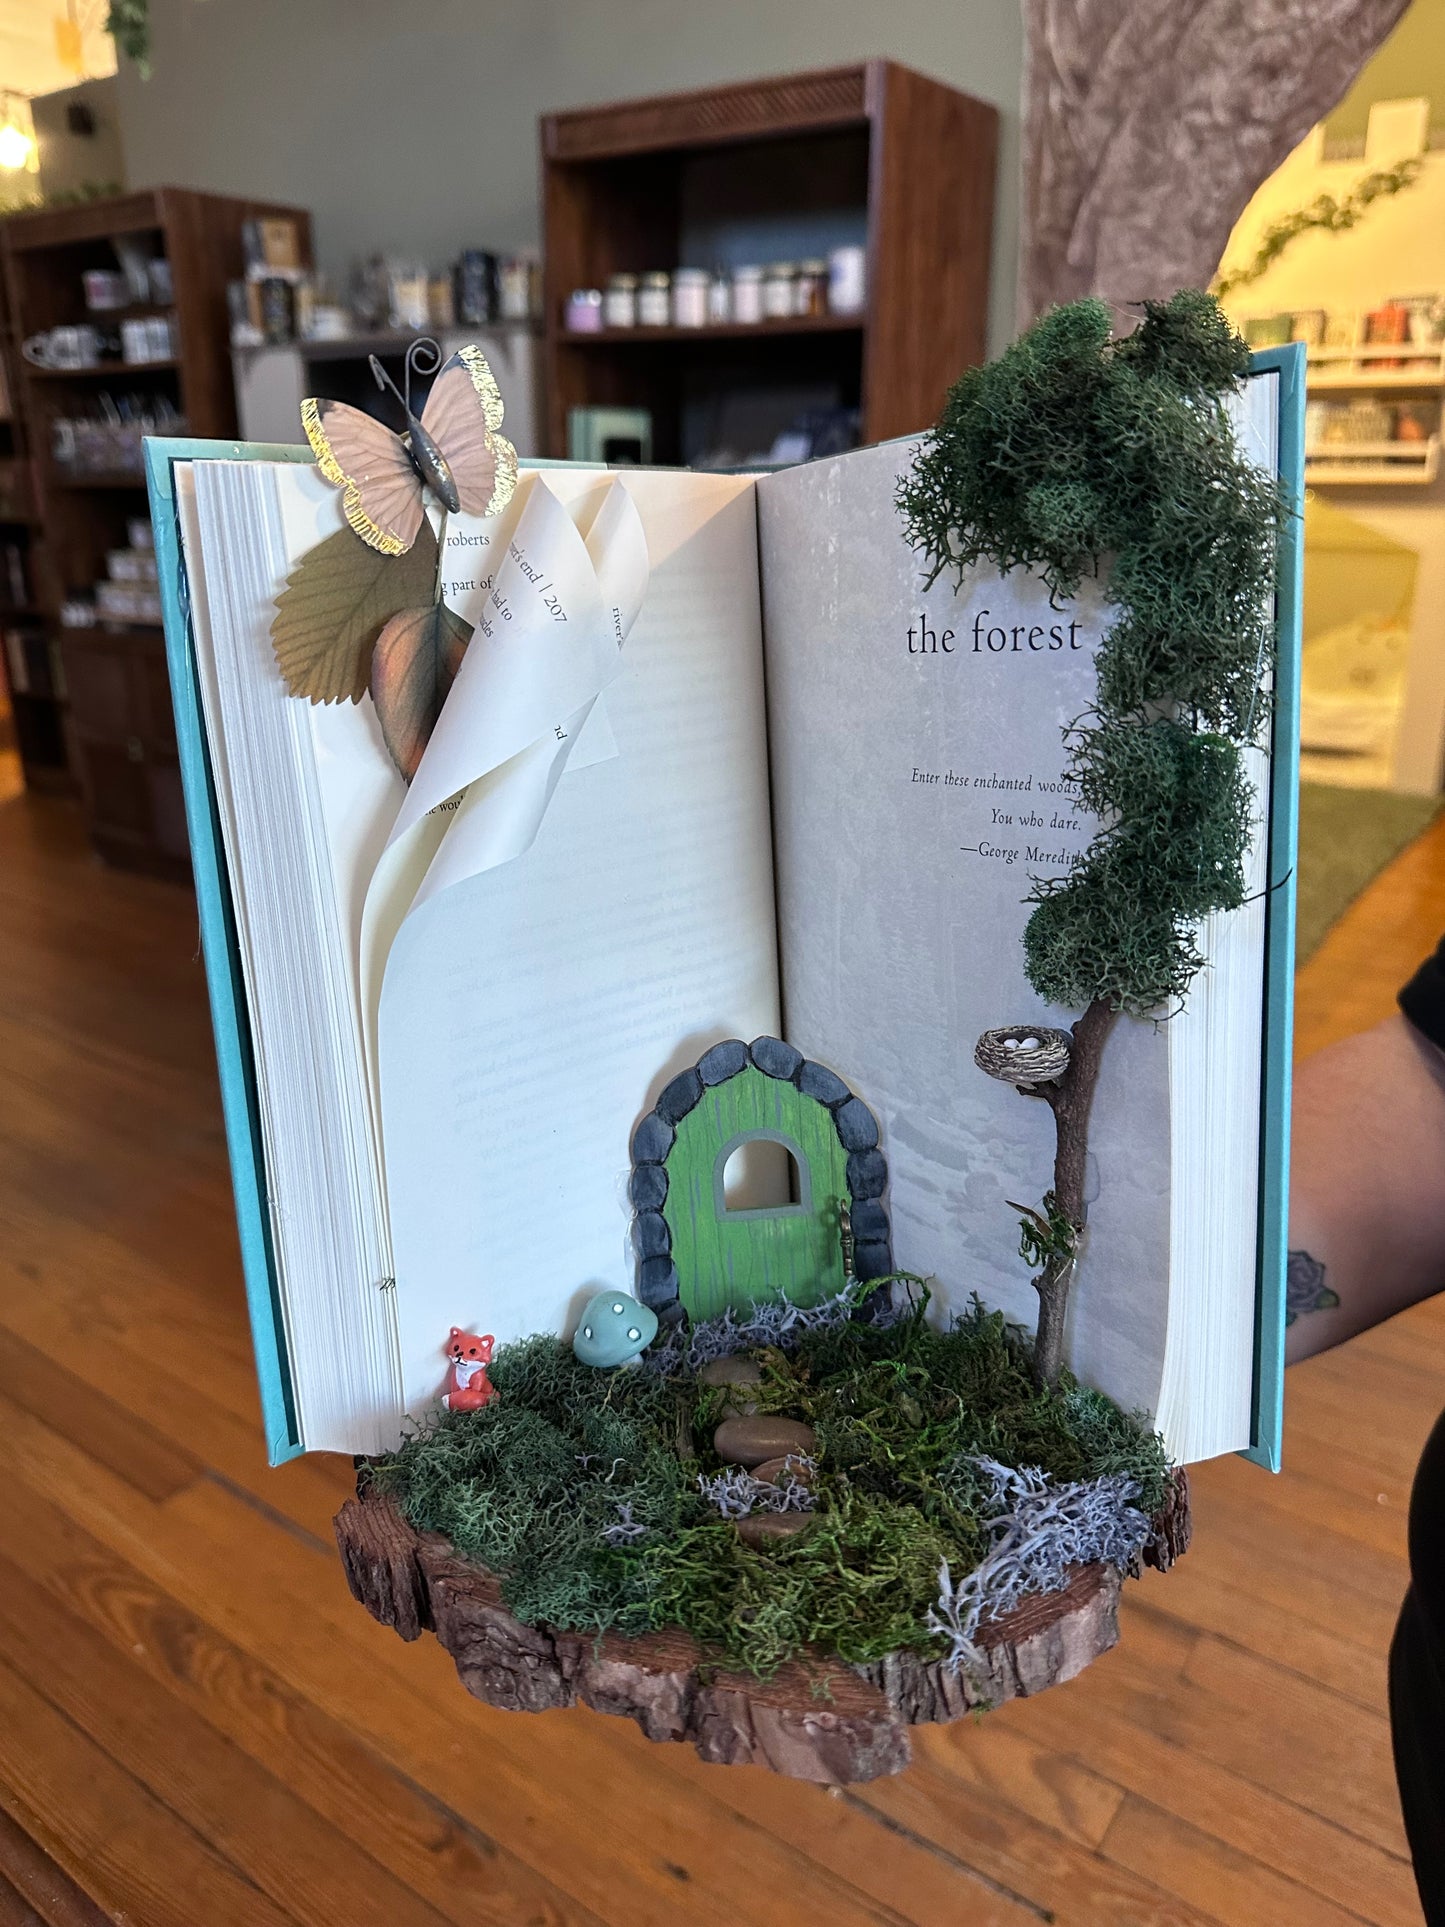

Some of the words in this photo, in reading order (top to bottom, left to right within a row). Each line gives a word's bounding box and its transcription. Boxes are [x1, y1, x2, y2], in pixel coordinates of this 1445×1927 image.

[447, 531, 490, 547] roberts
[451, 579, 475, 596] part
[480, 574, 493, 589] of
[520, 561, 544, 584] end
[543, 595, 568, 622] 207
[501, 607, 512, 620] to
[906, 613, 955, 653] the
[971, 610, 1083, 652] forest
[911, 767, 940, 784] Enter
[944, 769, 969, 787] these
[973, 772, 1033, 791] enchanted
[1038, 777, 1081, 798] woods,
[992, 808, 1013, 825] You
[1019, 810, 1043, 828] who
[1049, 811, 1081, 831] dare.
